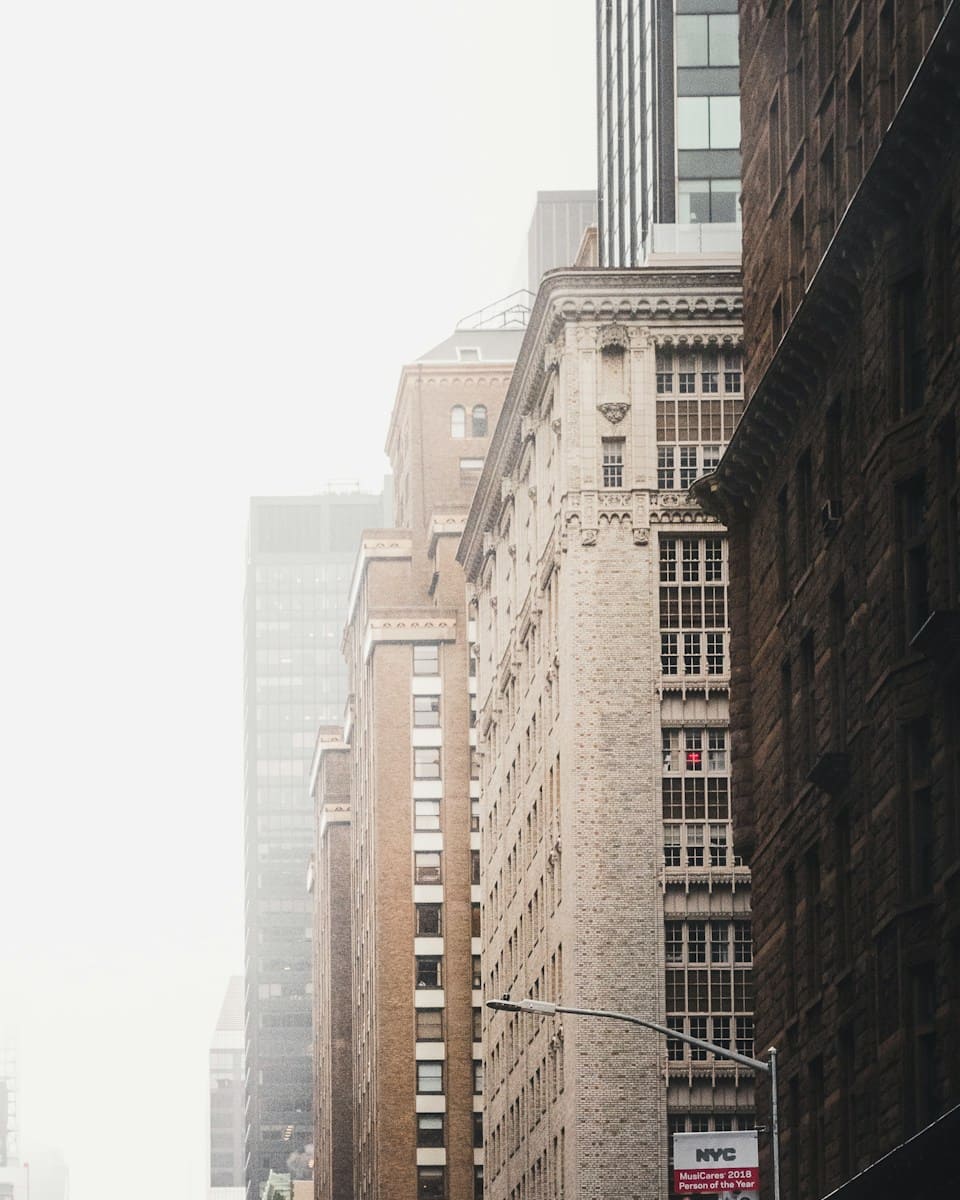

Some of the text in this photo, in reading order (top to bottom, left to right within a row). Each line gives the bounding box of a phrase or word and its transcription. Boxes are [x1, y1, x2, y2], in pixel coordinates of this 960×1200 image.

[696, 1147, 736, 1162] NYC
[728, 1170, 752, 1178] 2018
[679, 1182, 708, 1190] Person
[710, 1180, 719, 1189] of
[736, 1180, 755, 1188] Year
